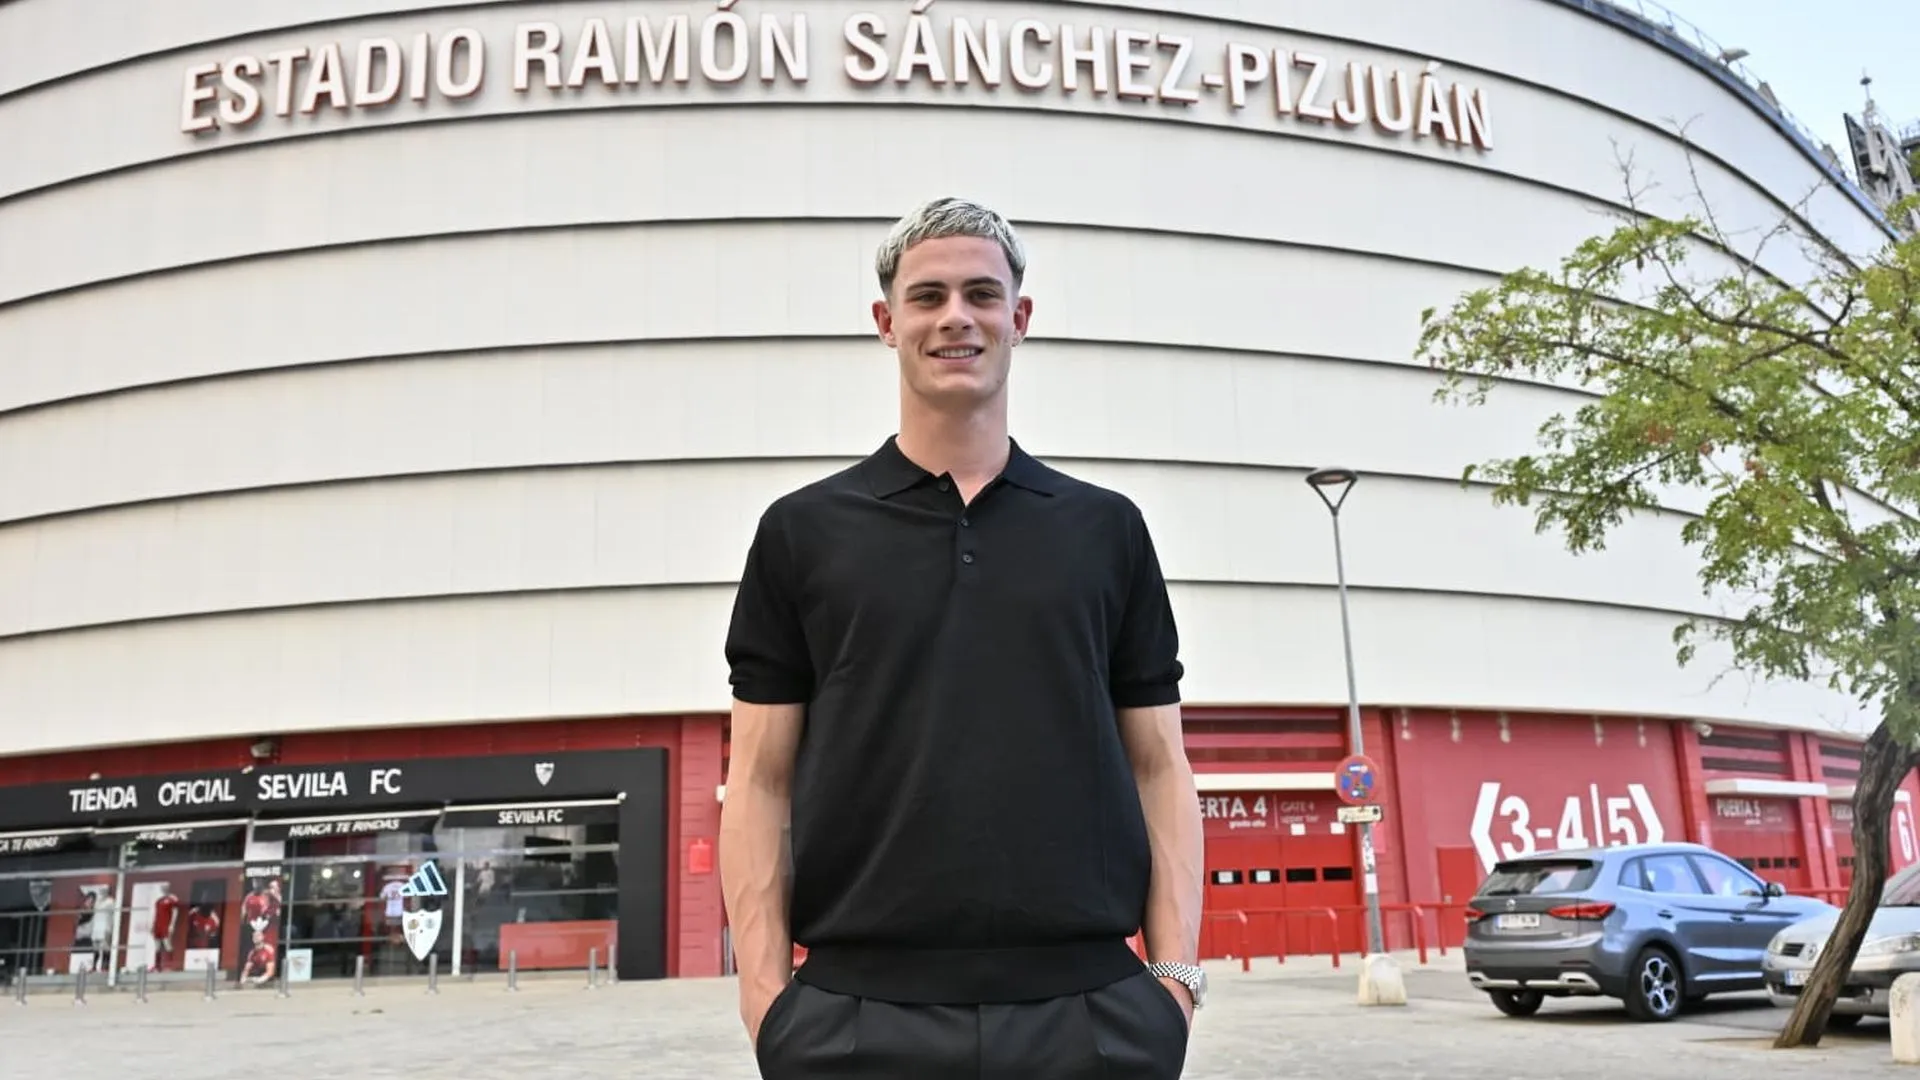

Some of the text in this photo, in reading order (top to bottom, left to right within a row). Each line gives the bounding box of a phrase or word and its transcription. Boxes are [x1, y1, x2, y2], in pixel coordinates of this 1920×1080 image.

[180, 0, 1493, 150] ESTADIO RAMÓN SÁNCHEZ-PIZJUÁN
[69, 769, 401, 812] TIENDA OFICIAL SEVILLA FC
[498, 808, 564, 824] SEVILLA FC
[1199, 796, 1267, 818] ERTA 4
[288, 823, 331, 838] NUNCA
[336, 821, 351, 833] TE
